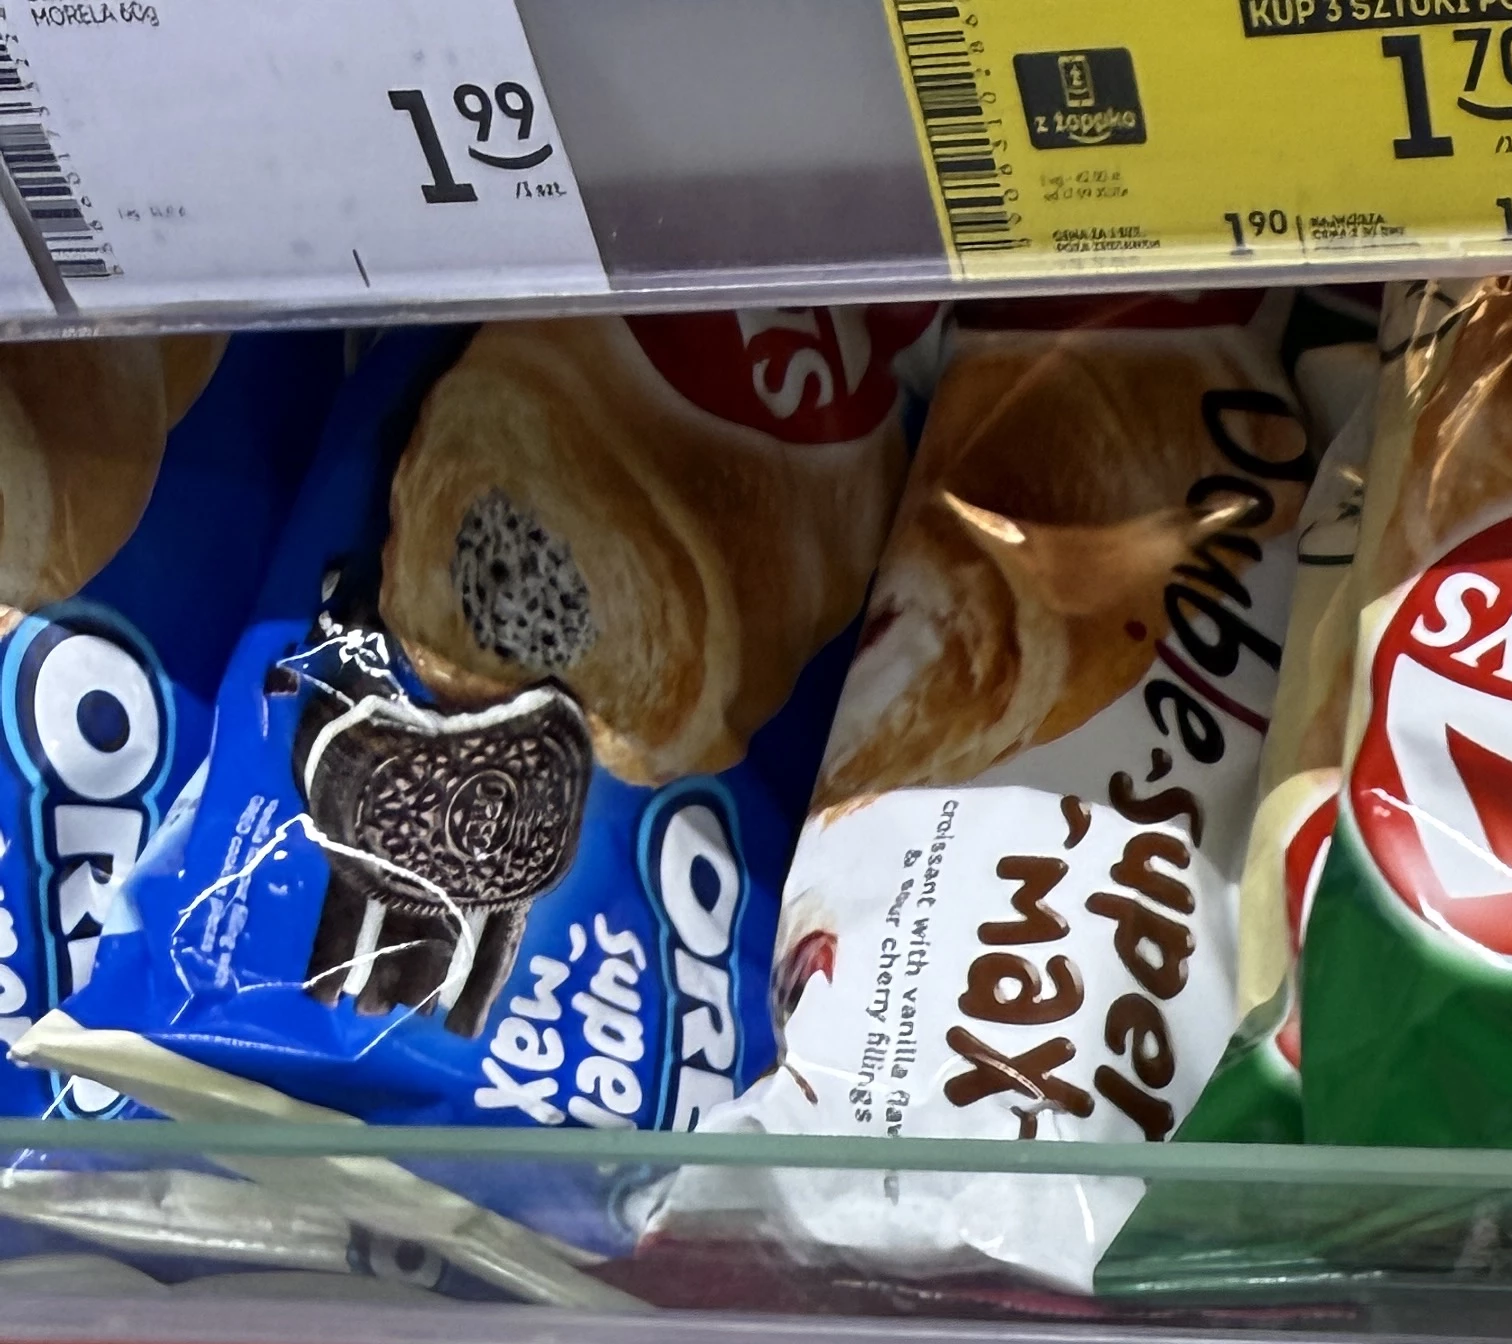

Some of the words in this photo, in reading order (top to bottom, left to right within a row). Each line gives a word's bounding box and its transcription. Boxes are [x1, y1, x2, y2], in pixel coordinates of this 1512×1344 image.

[31, 3, 118, 27] MORELA
[1250, 0, 1315, 28] KUP
[917, 799, 960, 908] croissant
[865, 937, 902, 1023] cherry
[904, 917, 931, 977] with
[890, 987, 918, 1080] vanilla
[848, 1031, 892, 1123] fillings
